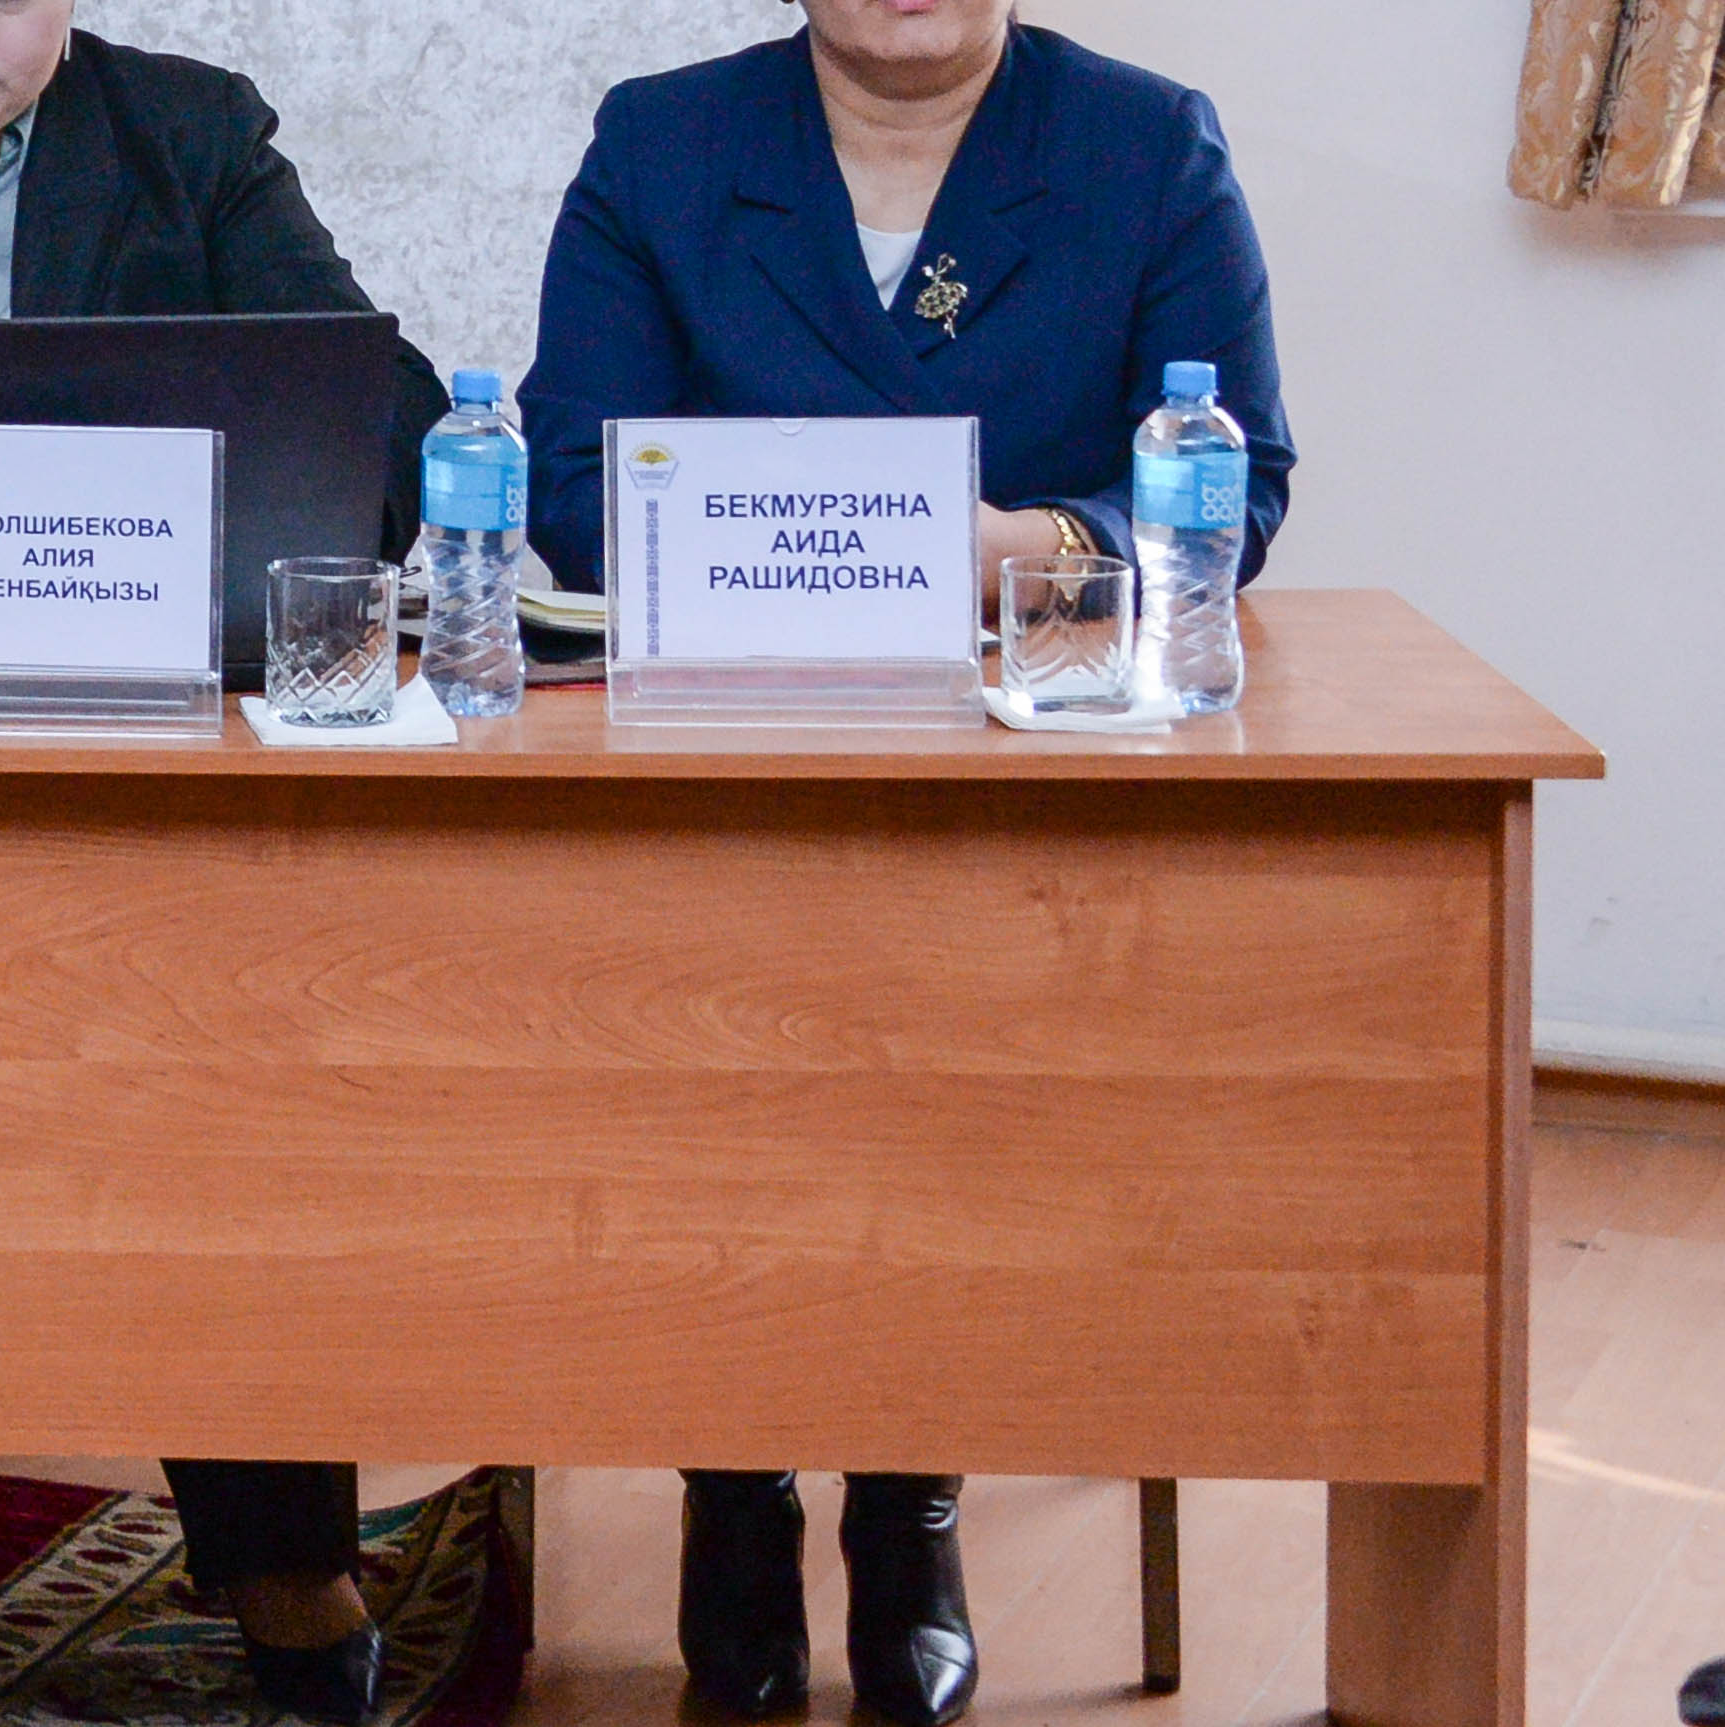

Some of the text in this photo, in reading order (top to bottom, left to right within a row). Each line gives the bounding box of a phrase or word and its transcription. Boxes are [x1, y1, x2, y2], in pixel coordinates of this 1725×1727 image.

[704, 493, 933, 519] БЕКМУРЗИНА
[21, 547, 94, 568] АЛИЯ
[770, 529, 866, 559] АИДА
[709, 564, 930, 595] РАШИДОВНА
